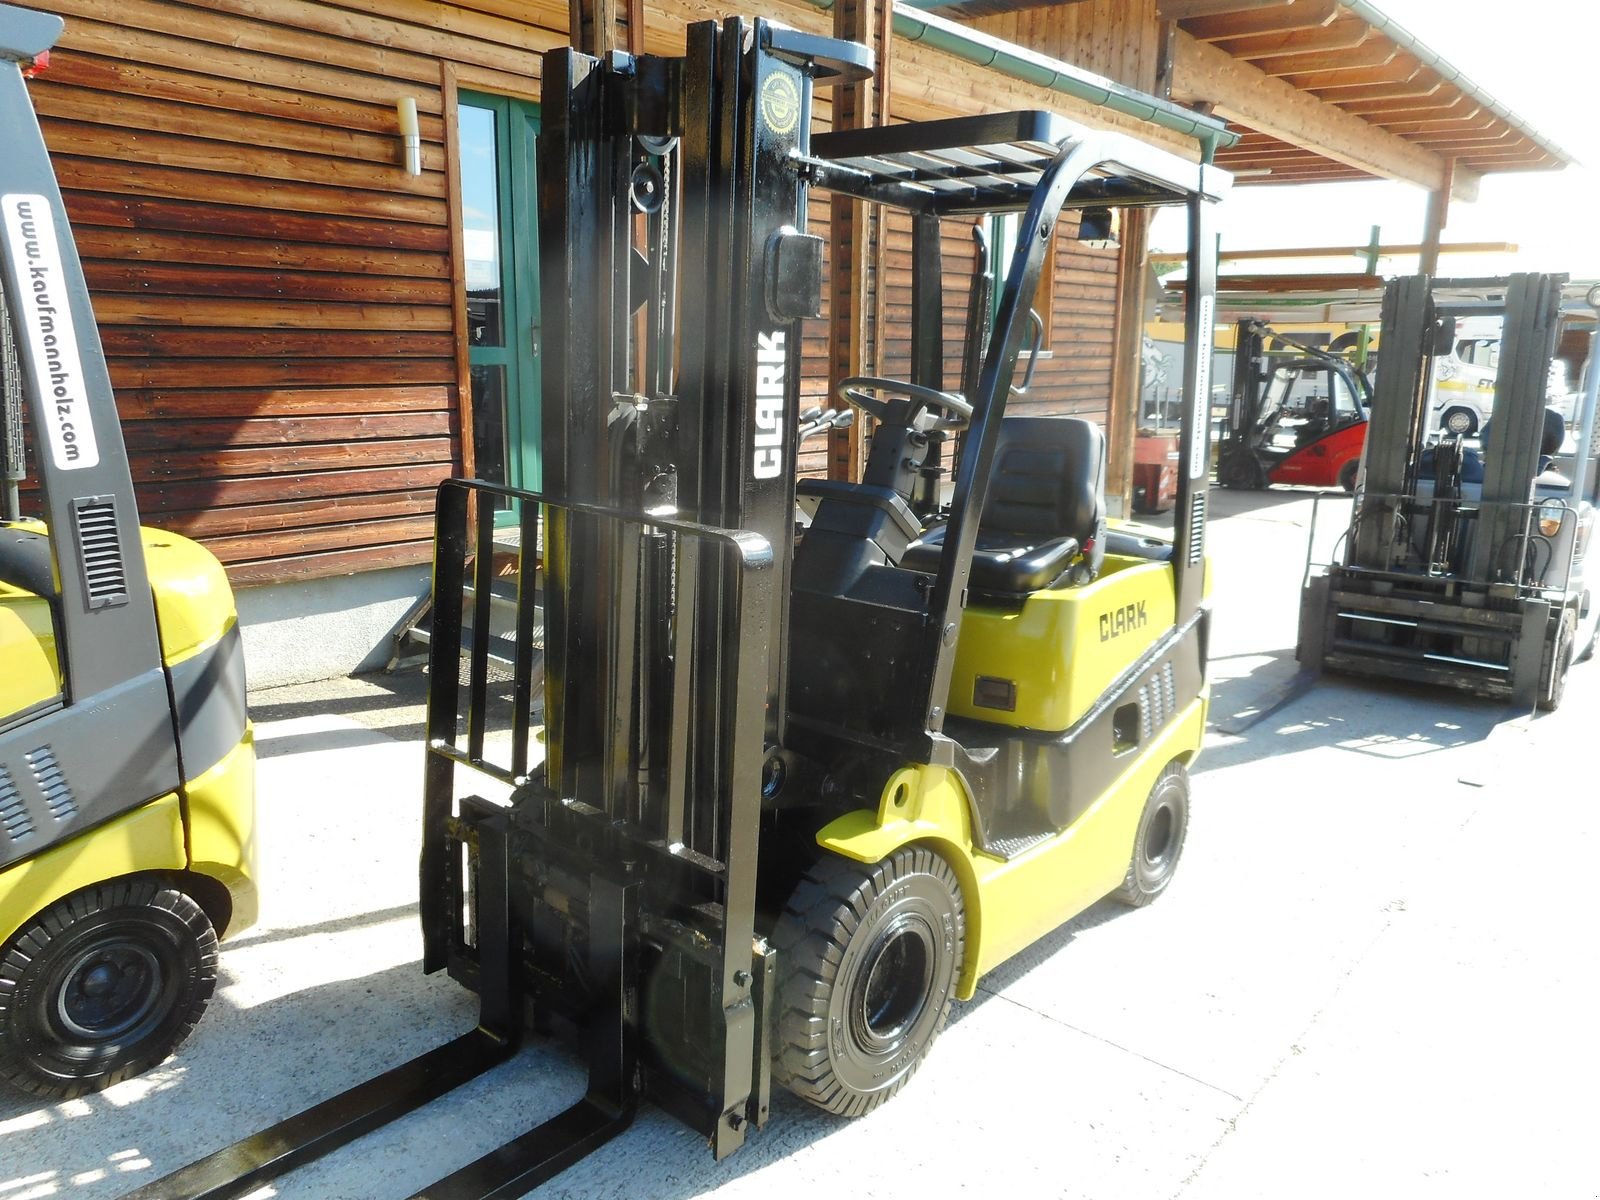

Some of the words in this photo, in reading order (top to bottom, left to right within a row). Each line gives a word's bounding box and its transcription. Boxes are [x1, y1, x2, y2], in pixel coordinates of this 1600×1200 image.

[17, 200, 82, 461] www.kaufmannholz.com
[753, 330, 787, 480] CLARK
[1099, 600, 1147, 642] CLARK
